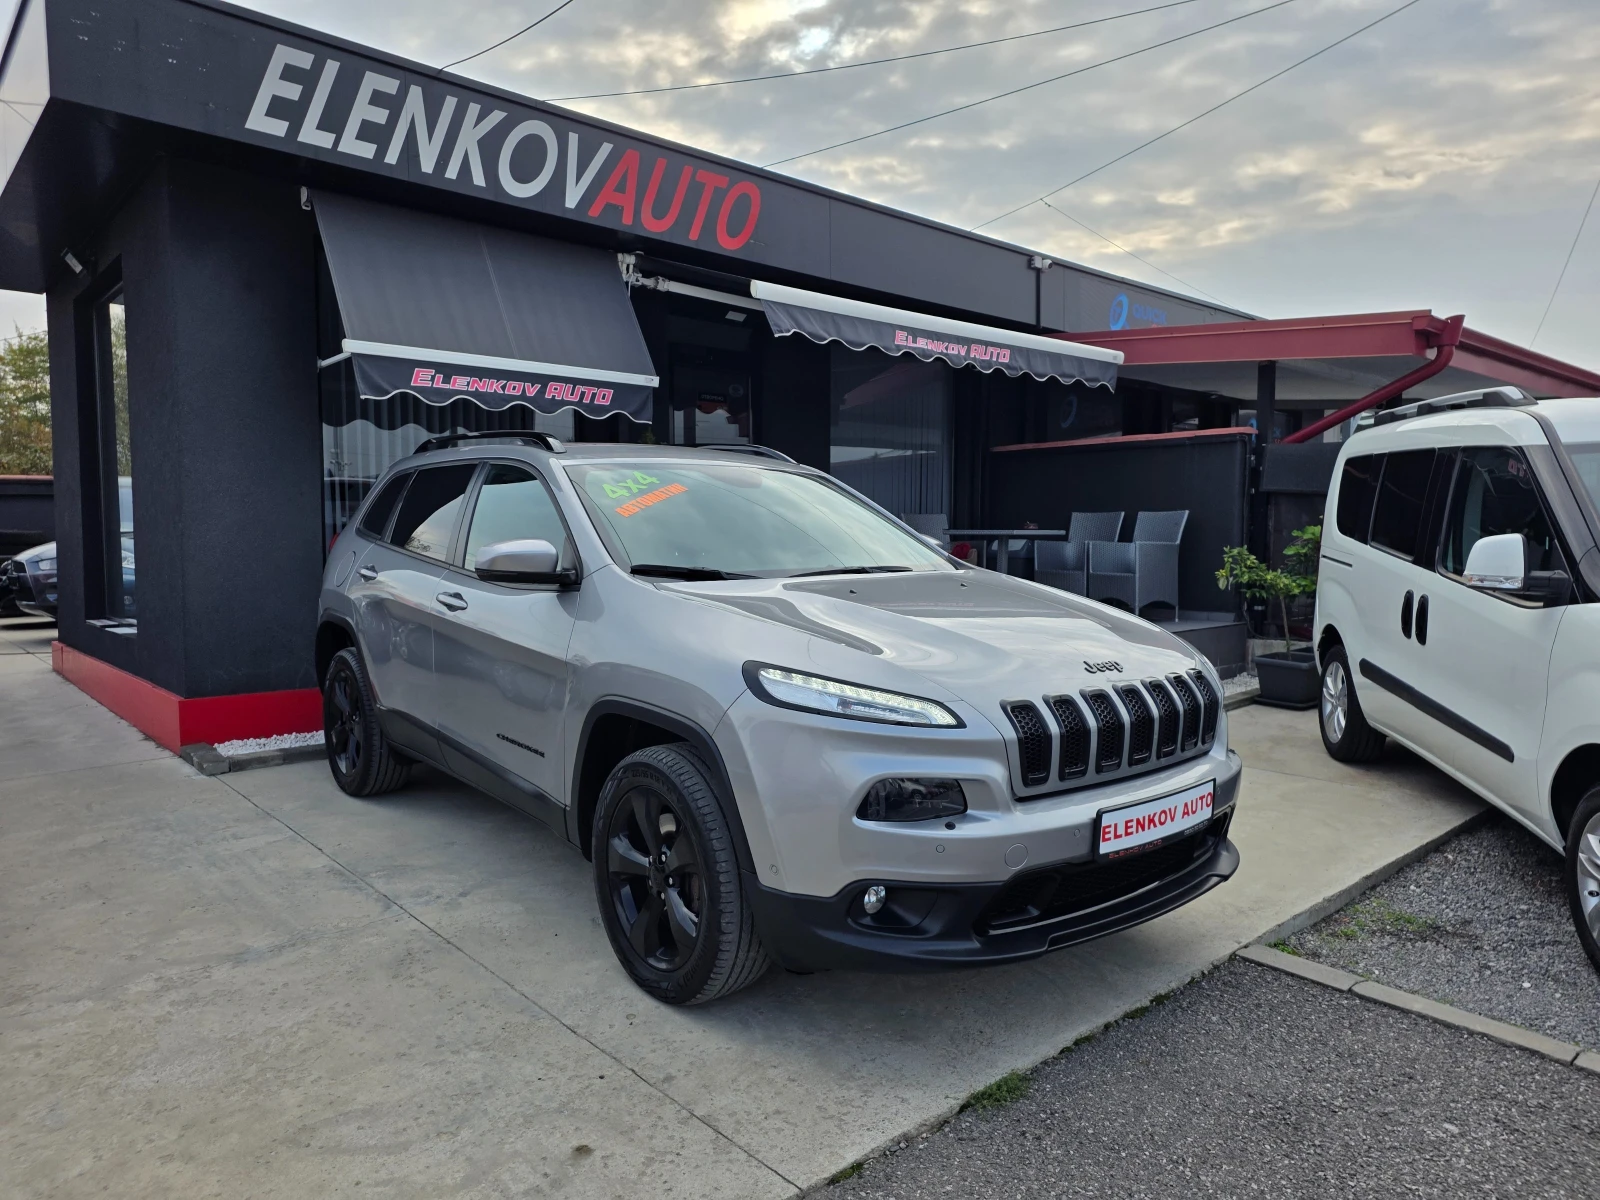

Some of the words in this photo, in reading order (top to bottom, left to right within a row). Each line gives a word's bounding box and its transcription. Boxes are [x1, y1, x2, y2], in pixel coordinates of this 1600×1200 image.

[969, 343, 1011, 364] AUTO
[545, 382, 615, 406] AUTO
[1083, 660, 1124, 674] Jeep
[1101, 804, 1178, 843] ELENKOV
[1181, 791, 1214, 820] AUTO
[1144, 839, 1163, 850] AUTO
